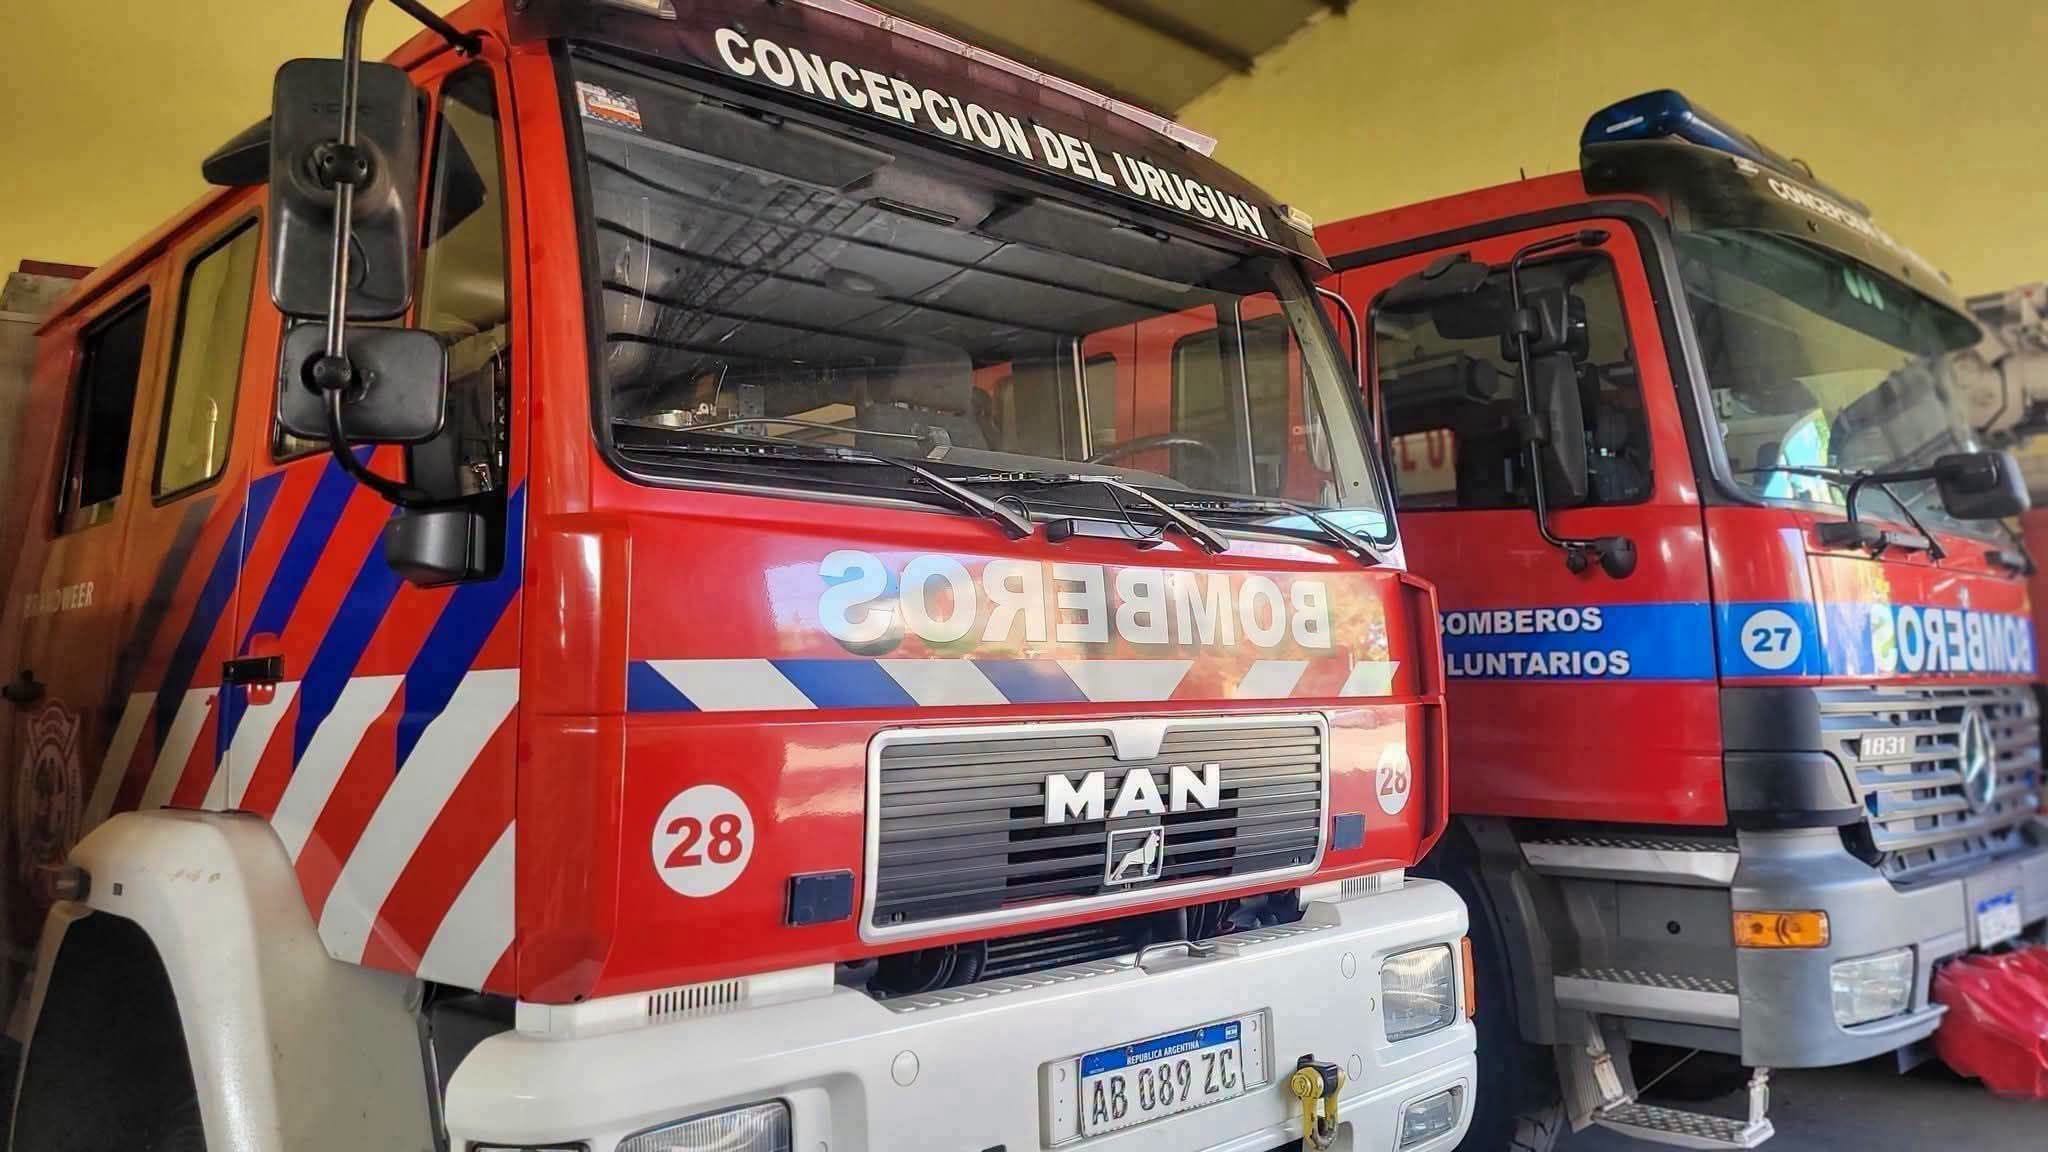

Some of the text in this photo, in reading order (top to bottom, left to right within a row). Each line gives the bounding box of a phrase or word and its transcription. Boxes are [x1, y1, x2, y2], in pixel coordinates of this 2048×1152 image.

[714, 27, 1270, 240] CONCEPCION DEL URUGUAY
[1751, 627, 1793, 652] 27
[1447, 650, 1630, 676] LUNTARIOS
[1861, 736, 1907, 757] 1831
[1044, 763, 1220, 824] MAN
[1380, 763, 1408, 796] 28
[663, 813, 743, 869] 28
[1126, 1039, 1200, 1065] REPUBLICA ARGENTINA
[1092, 1048, 1236, 1125] AB 089 ZC
